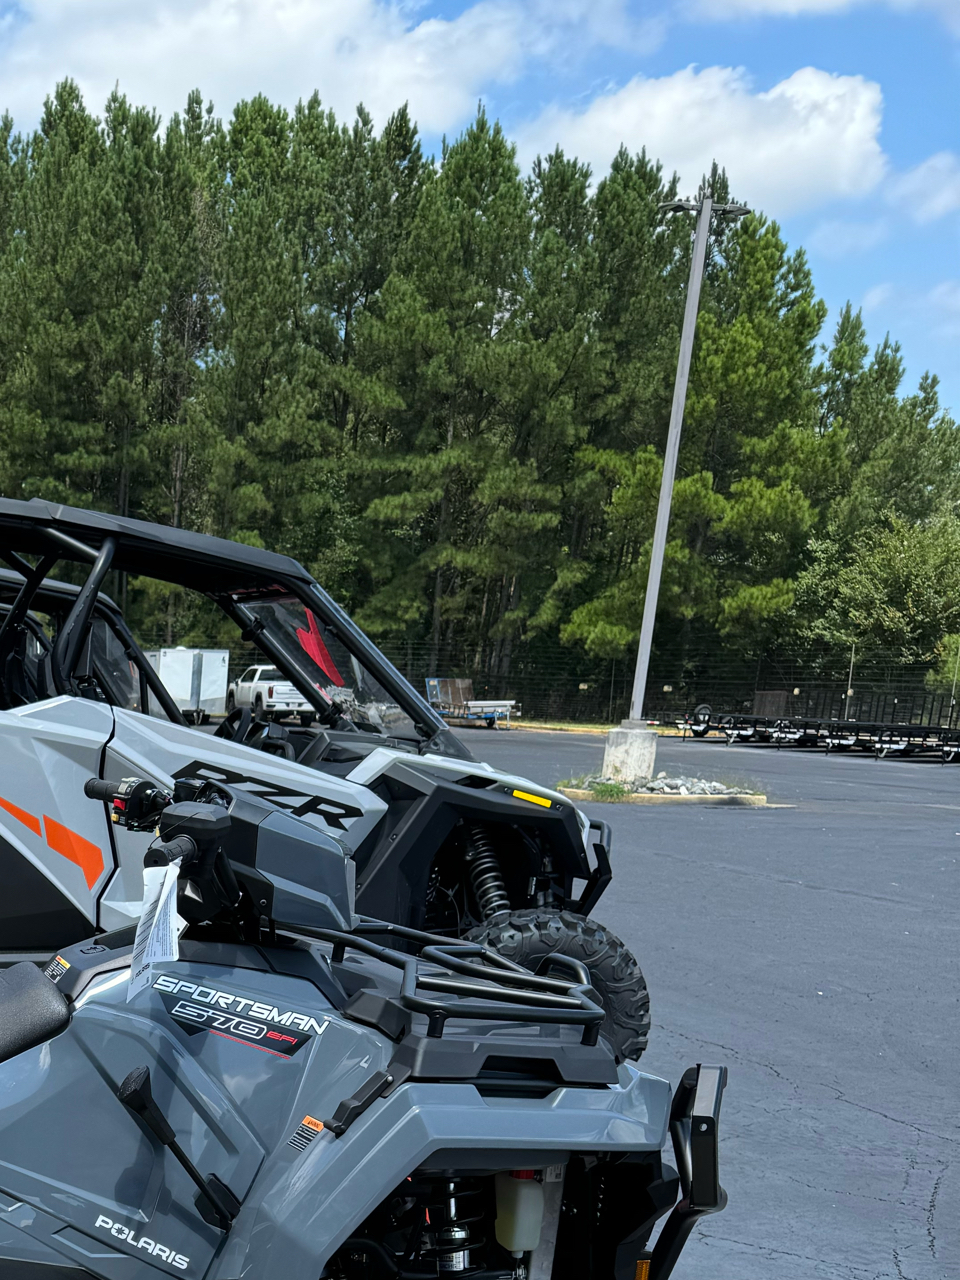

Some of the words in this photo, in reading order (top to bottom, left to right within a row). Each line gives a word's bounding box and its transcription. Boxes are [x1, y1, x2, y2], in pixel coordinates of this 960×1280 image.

[152, 975, 330, 1035] SPORTSMAN
[171, 1002, 268, 1040] 570
[266, 1030, 300, 1046] EFI
[94, 1214, 190, 1271] POLARIS
